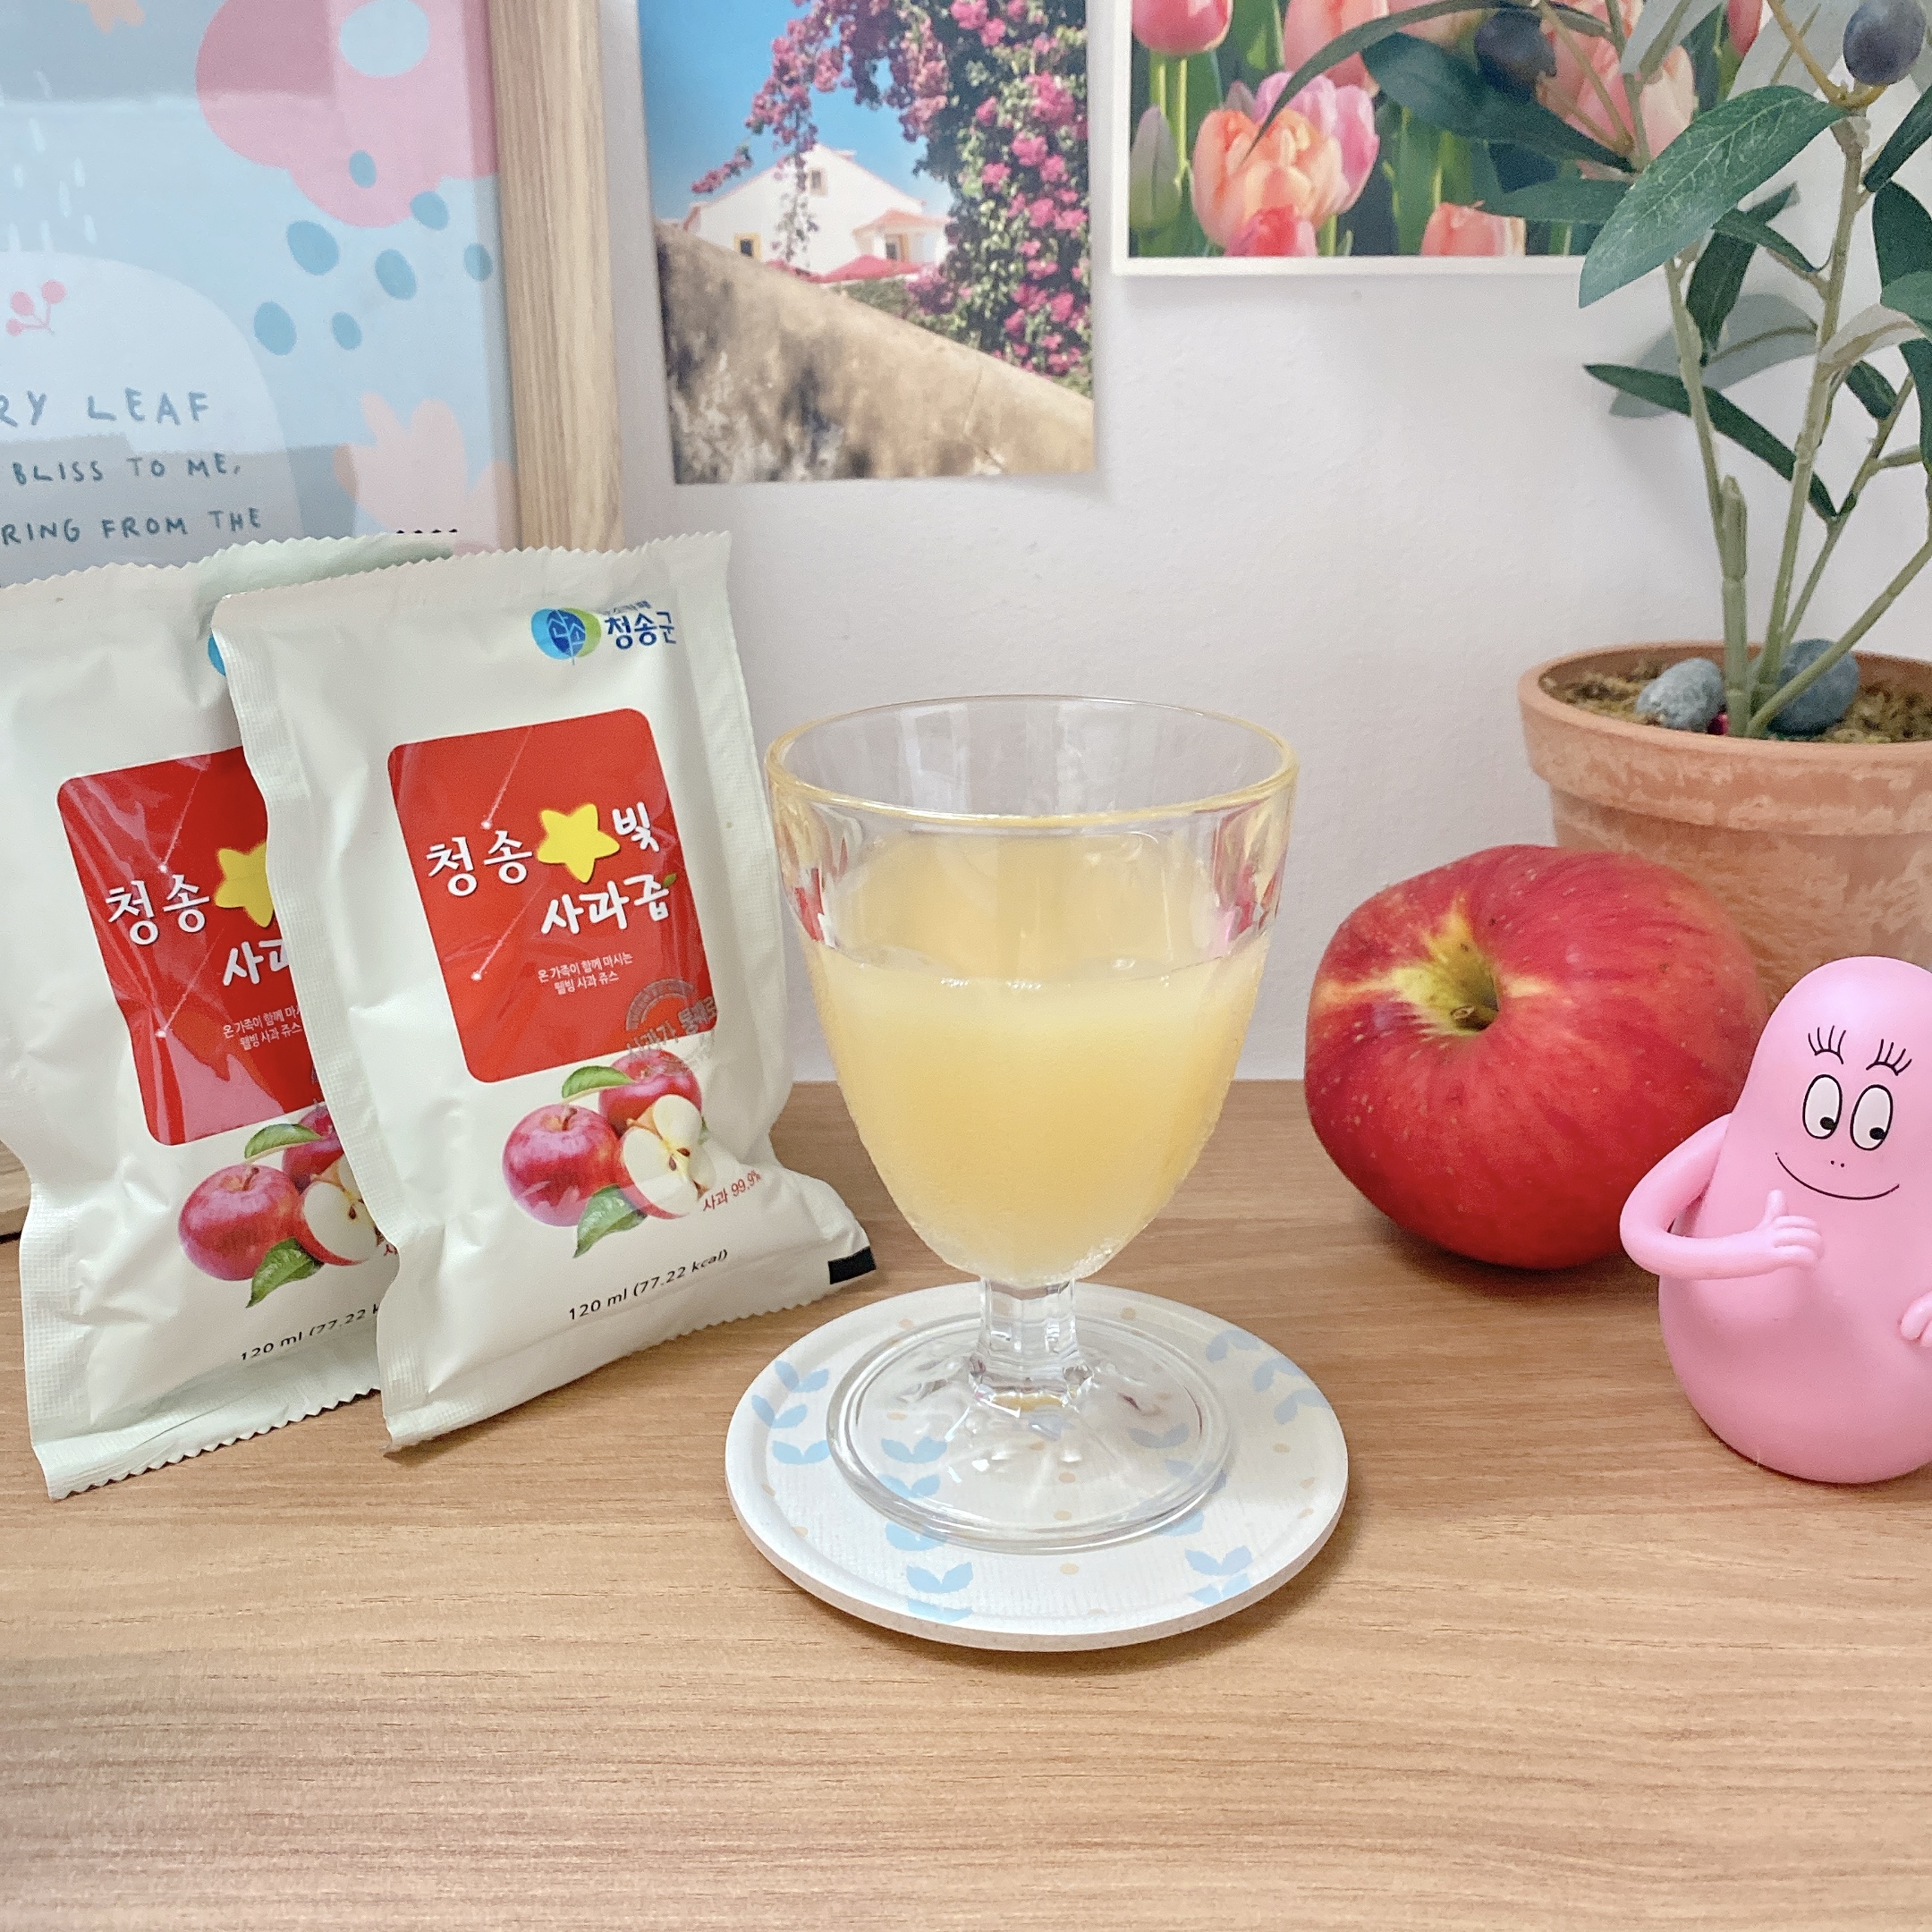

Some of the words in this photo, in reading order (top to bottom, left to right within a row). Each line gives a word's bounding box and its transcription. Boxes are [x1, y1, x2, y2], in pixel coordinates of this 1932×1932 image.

[87, 386, 209, 425] LEAF
[13, 461, 104, 485] BLISS
[126, 457, 166, 478] TO
[1, 518, 80, 546] RING
[101, 516, 188, 538] FROM
[207, 507, 261, 531] THE
[605, 612, 677, 649] 청송군
[426, 830, 533, 896] 청송
[612, 801, 660, 852] 빛
[106, 874, 211, 945] 청송
[540, 873, 670, 935] 사과즙
[602, 952, 633, 968] 마시는
[577, 974, 597, 989] 사과
[598, 970, 619, 985] 쥬스
[261, 1027, 280, 1043] 사과
[281, 1022, 303, 1038] 쥬스
[703, 1187, 728, 1211] 사과
[569, 1300, 601, 1320] 120
[607, 1288, 627, 1307] ml
[633, 1266, 686, 1297] (77.22
[691, 1249, 728, 1273] kcal)
[241, 1343, 275, 1360] 120
[280, 1332, 302, 1347] ml
